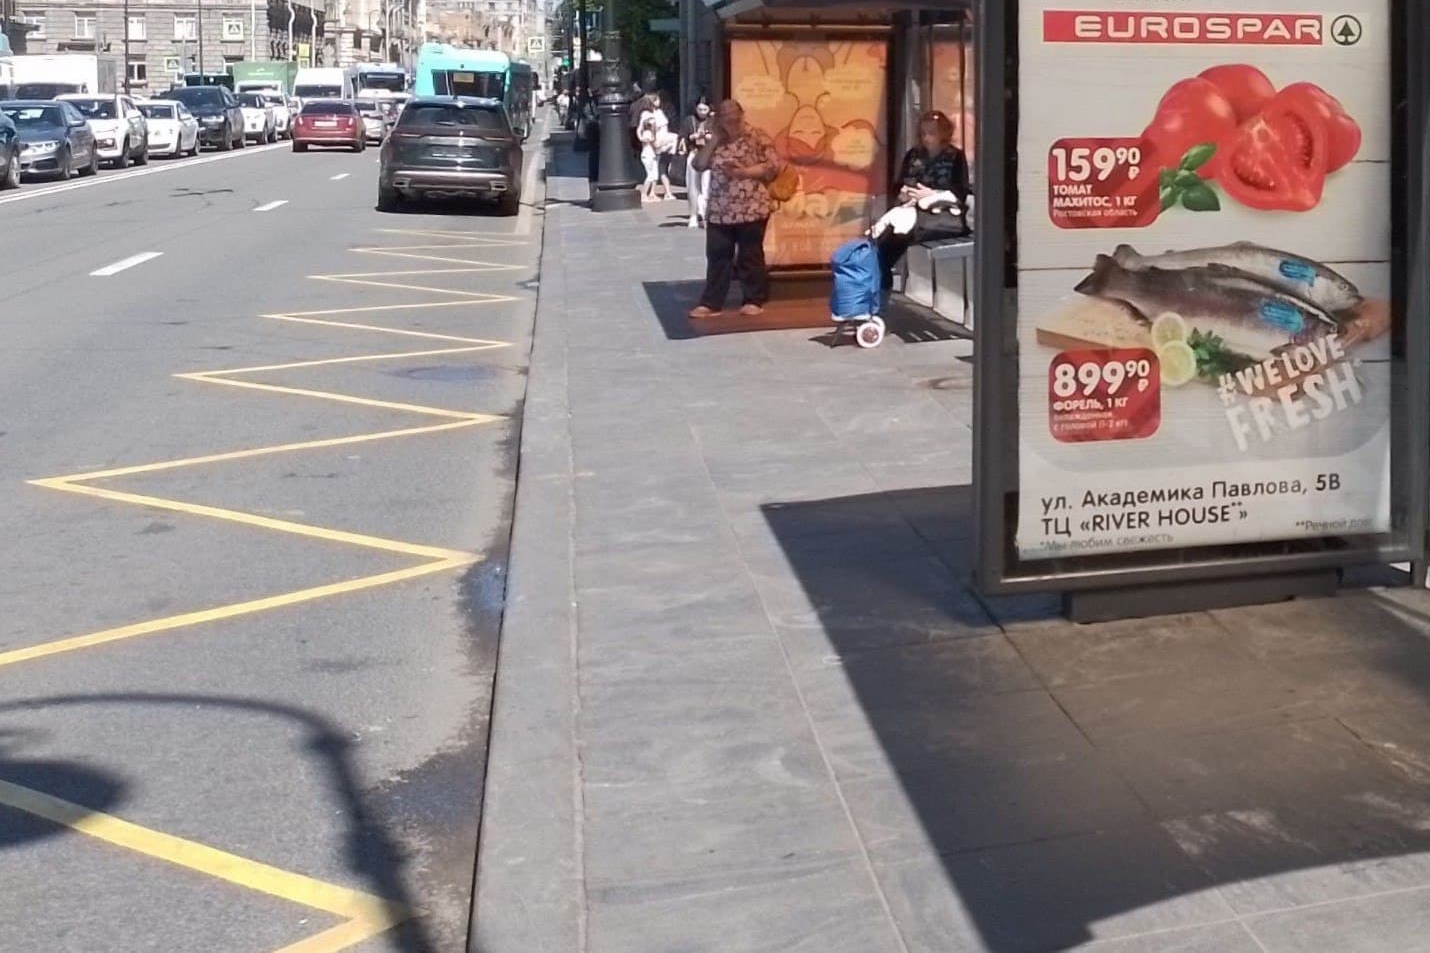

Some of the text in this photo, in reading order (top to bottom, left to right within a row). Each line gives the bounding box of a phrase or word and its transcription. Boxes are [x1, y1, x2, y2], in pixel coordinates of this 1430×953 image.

[1074, 15, 1322, 41] EUROSPAR
[1053, 184, 1093, 195] ТОМАТ
[1116, 196, 1121, 206] 1
[1281, 333, 1345, 378] LOVE
[1107, 398, 1113, 408] 1
[1041, 473, 1341, 515] ул. Академика Павлова, 5В
[1041, 516, 1072, 537] ТЦ
[1080, 511, 1150, 532] «RIVER
